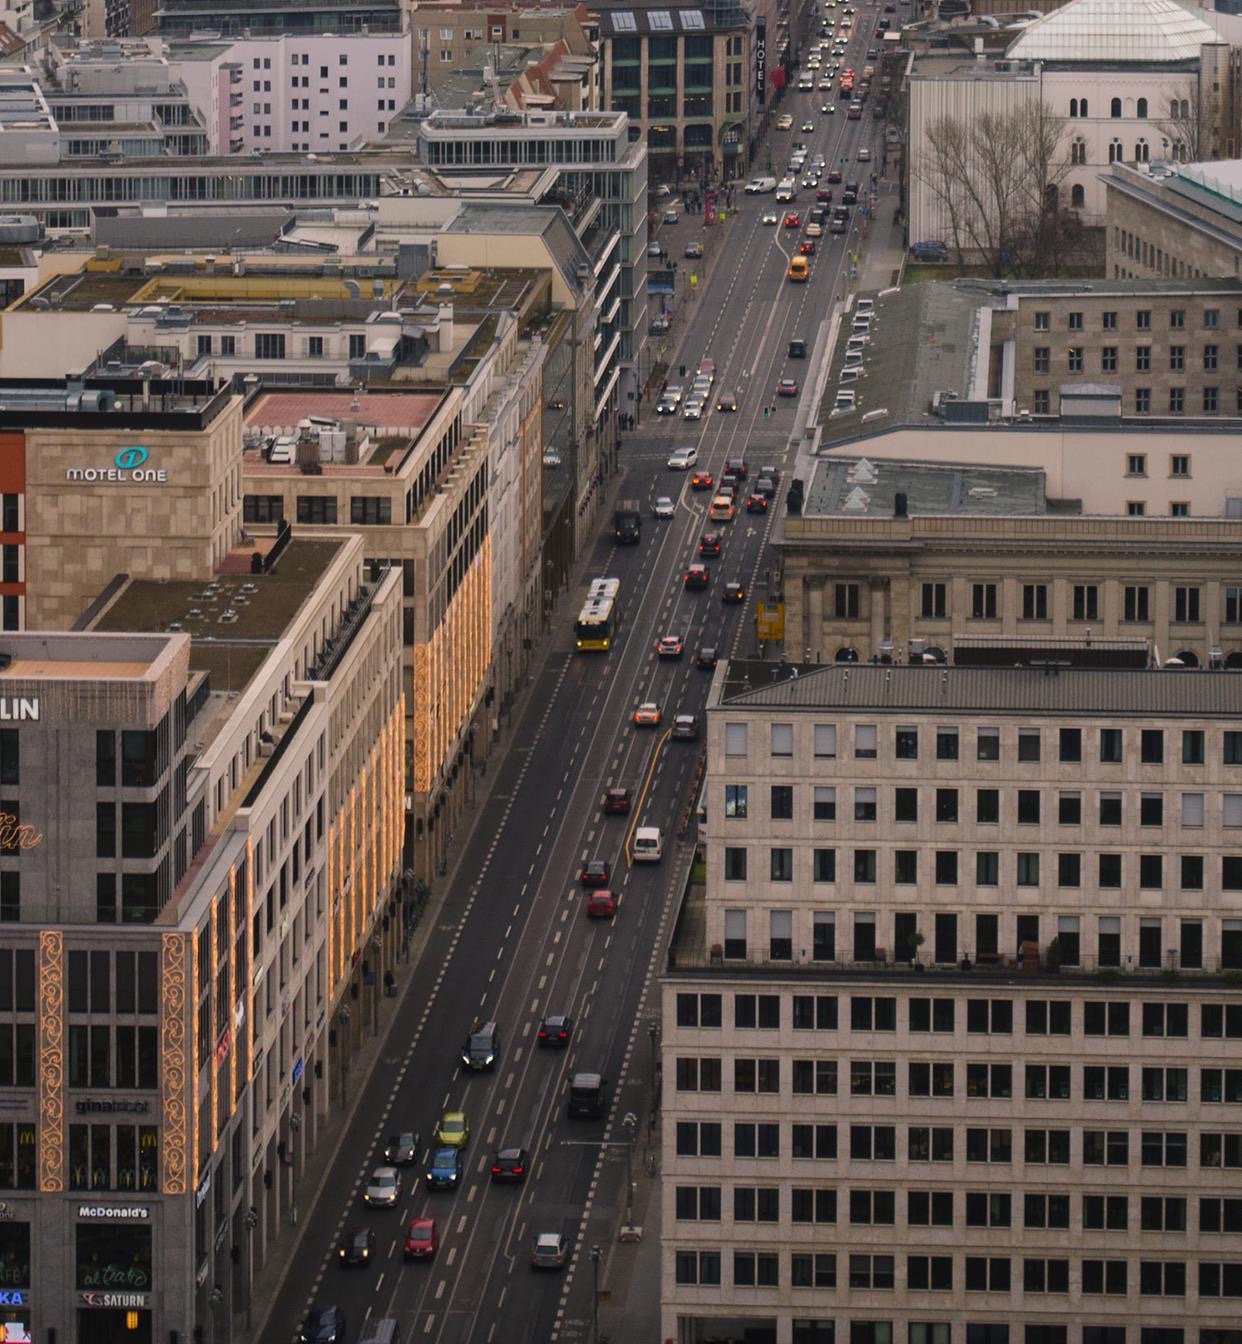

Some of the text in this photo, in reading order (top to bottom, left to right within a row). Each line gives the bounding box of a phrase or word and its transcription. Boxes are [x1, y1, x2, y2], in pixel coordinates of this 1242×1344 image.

[756, 40, 766, 91] HOTEL
[66, 468, 167, 481] MOTEL ONE
[0, 698, 39, 720] LIN
[79, 1207, 148, 1218] McDonald's
[103, 1294, 145, 1306] SATURN
